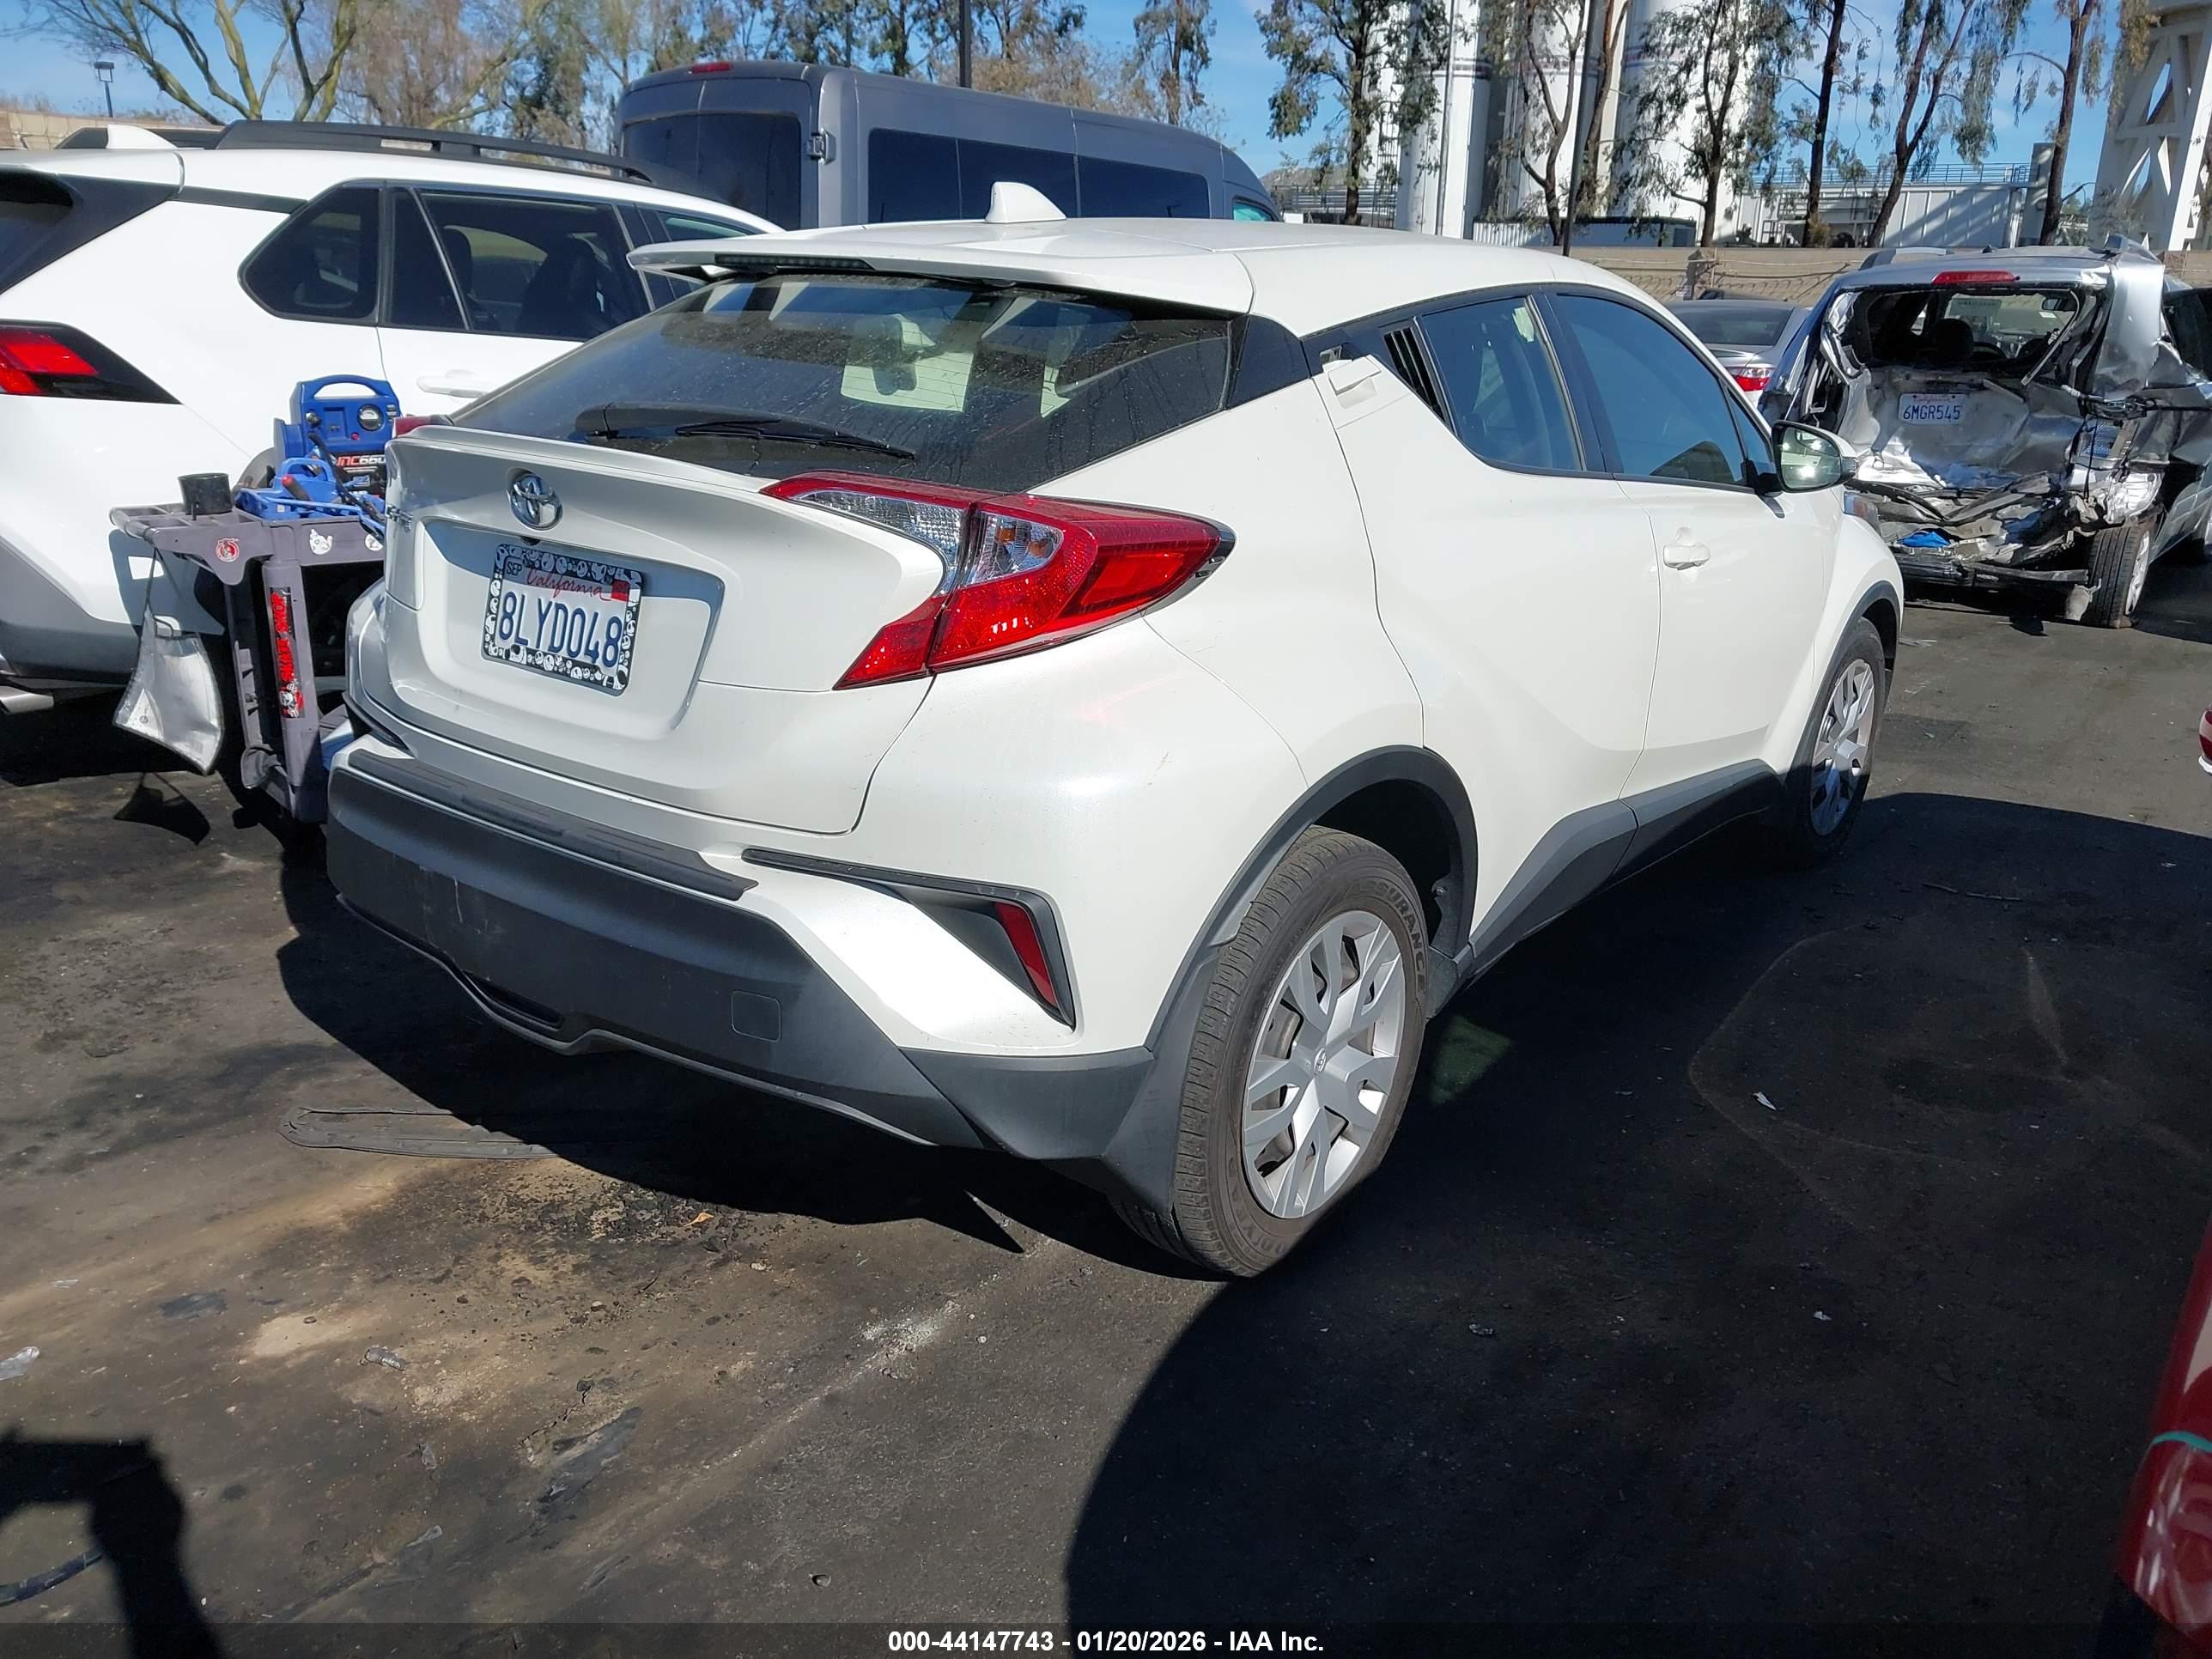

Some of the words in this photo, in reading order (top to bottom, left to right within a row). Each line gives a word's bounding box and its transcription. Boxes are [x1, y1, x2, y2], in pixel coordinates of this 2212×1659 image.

[1903, 404, 1961, 420] 6MGR545
[526, 568, 611, 601] California
[499, 591, 623, 667] 8LYD048
[1353, 879, 1428, 994] SURANCE
